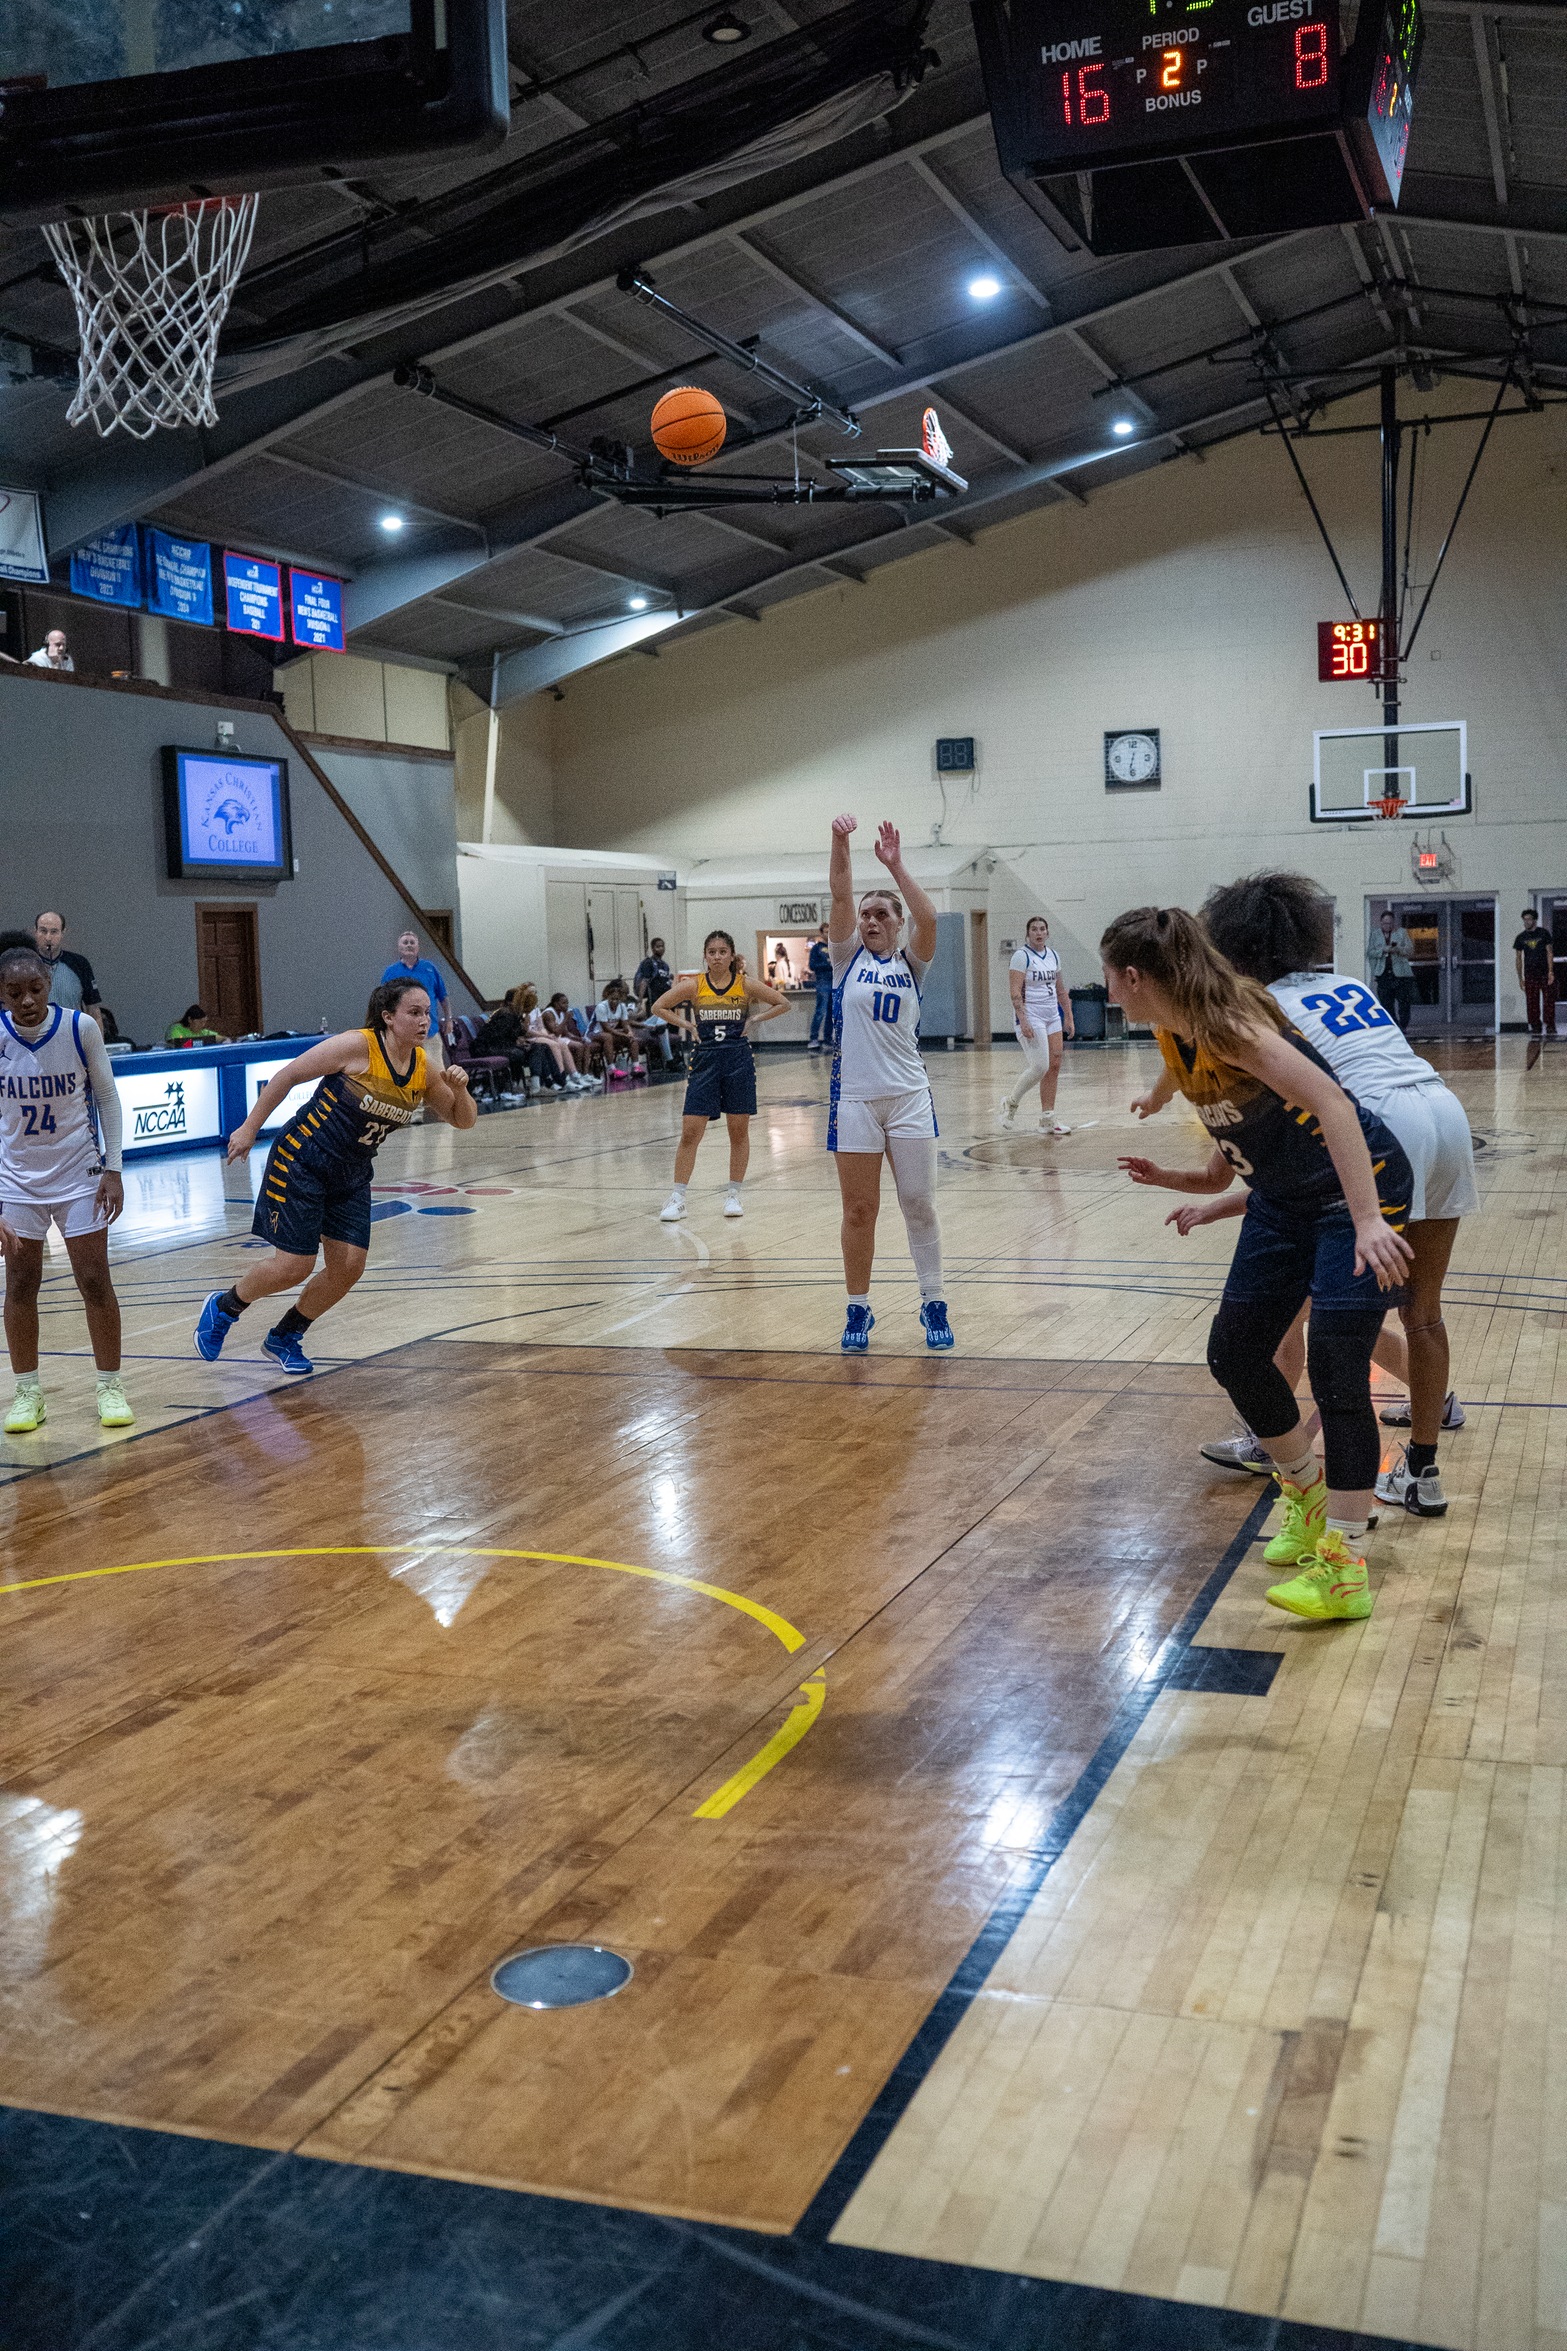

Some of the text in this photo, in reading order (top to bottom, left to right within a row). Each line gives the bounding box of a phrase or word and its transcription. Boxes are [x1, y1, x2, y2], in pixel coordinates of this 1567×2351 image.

[1247, 0, 1312, 26] GUEST
[1041, 36, 1102, 64] HOME
[1142, 28, 1200, 50] PERIOD
[1295, 24, 1327, 88] 8
[1136, 52, 1208, 87] P 2 P
[1062, 64, 1110, 125] 16
[1145, 90, 1202, 112] BONUS
[1334, 623, 1375, 642] 9:31
[1332, 643, 1367, 674] 30
[1128, 740, 1138, 749] 12
[1144, 753, 1151, 762] 3
[208, 835, 259, 854] COLLEGE
[779, 903, 817, 923] CONCESSIONS
[1045, 982, 1054, 996] 5
[699, 1008, 742, 1021] SABERCATS
[872, 990, 901, 1024] 10
[1301, 984, 1394, 1038] 22
[714, 1025, 727, 1042] 5
[0, 1072, 76, 1099] FALCONS
[20, 1103, 57, 1136] 24
[135, 1108, 186, 1135] NCCAA
[359, 1094, 413, 1124] SABERCAT
